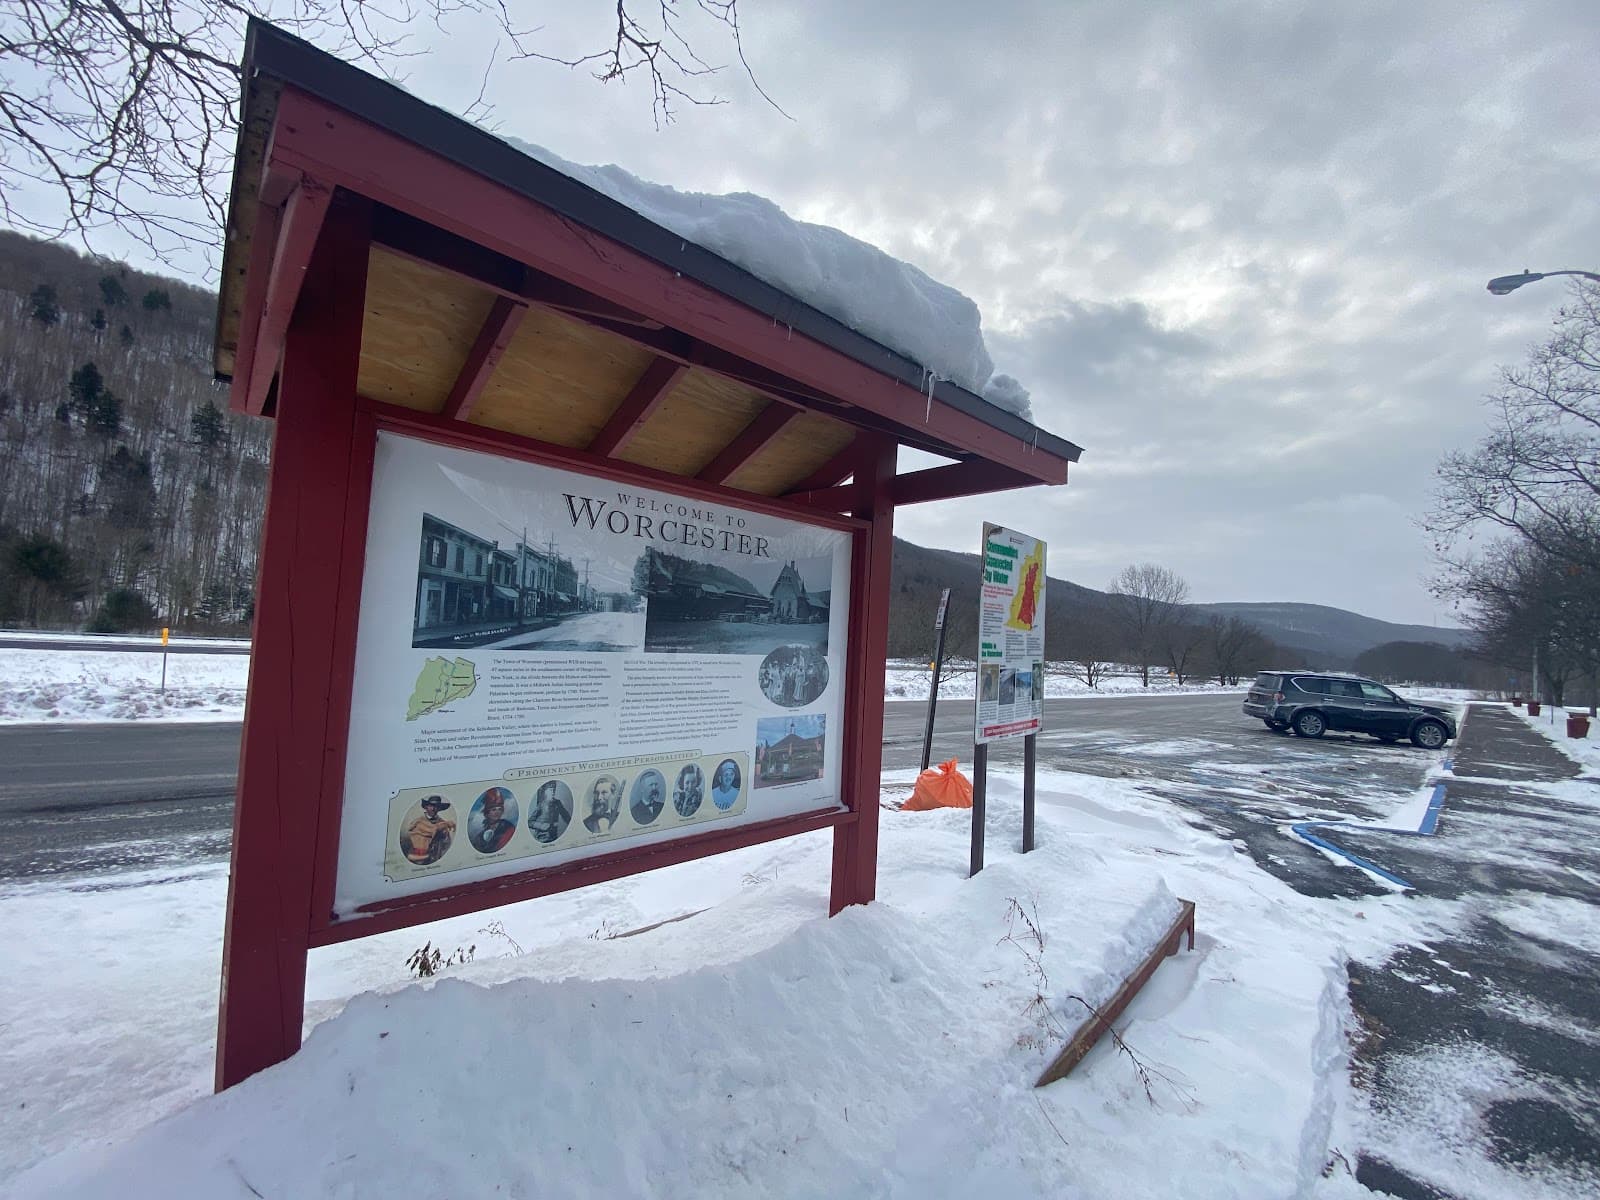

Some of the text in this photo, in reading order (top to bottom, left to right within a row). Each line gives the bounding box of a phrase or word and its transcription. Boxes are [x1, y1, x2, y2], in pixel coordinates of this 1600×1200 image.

[561, 493, 770, 558] WORCESTER
[617, 492, 746, 528] WELCOME TO
[518, 752, 694, 777] PROMINENT WORCESTER PERSONALITIES
